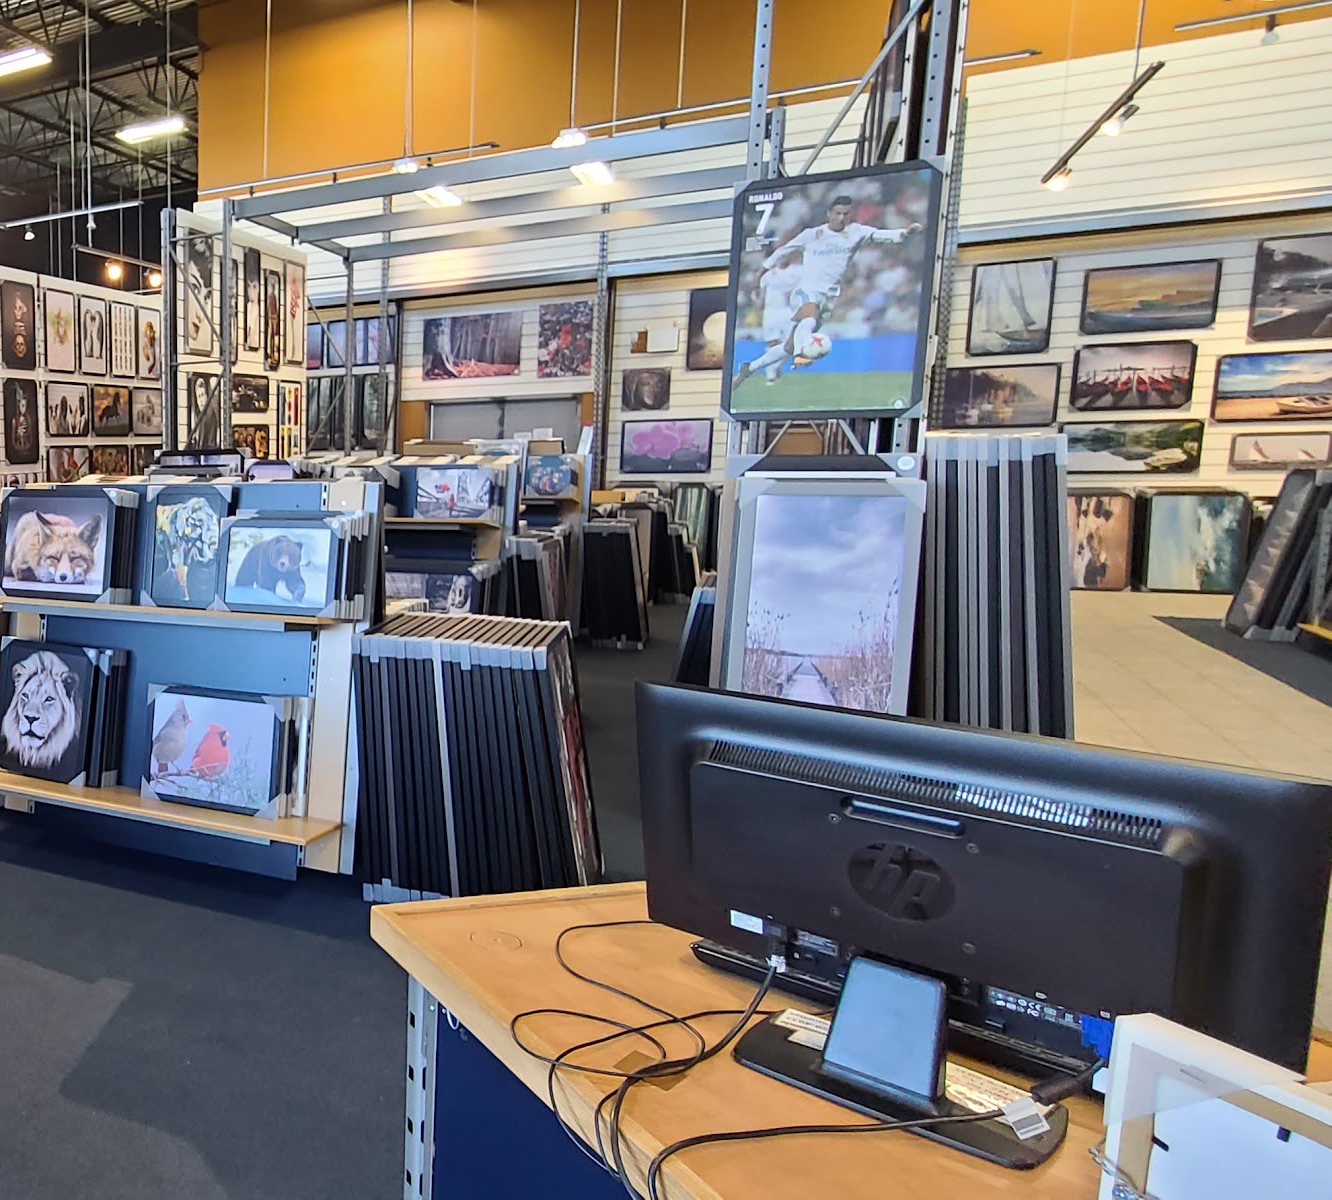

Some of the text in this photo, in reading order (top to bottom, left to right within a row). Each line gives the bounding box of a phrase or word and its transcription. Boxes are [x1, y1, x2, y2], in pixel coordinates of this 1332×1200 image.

[748, 191, 784, 204] RONALDO
[755, 203, 775, 235] 7
[864, 842, 943, 920] hp
